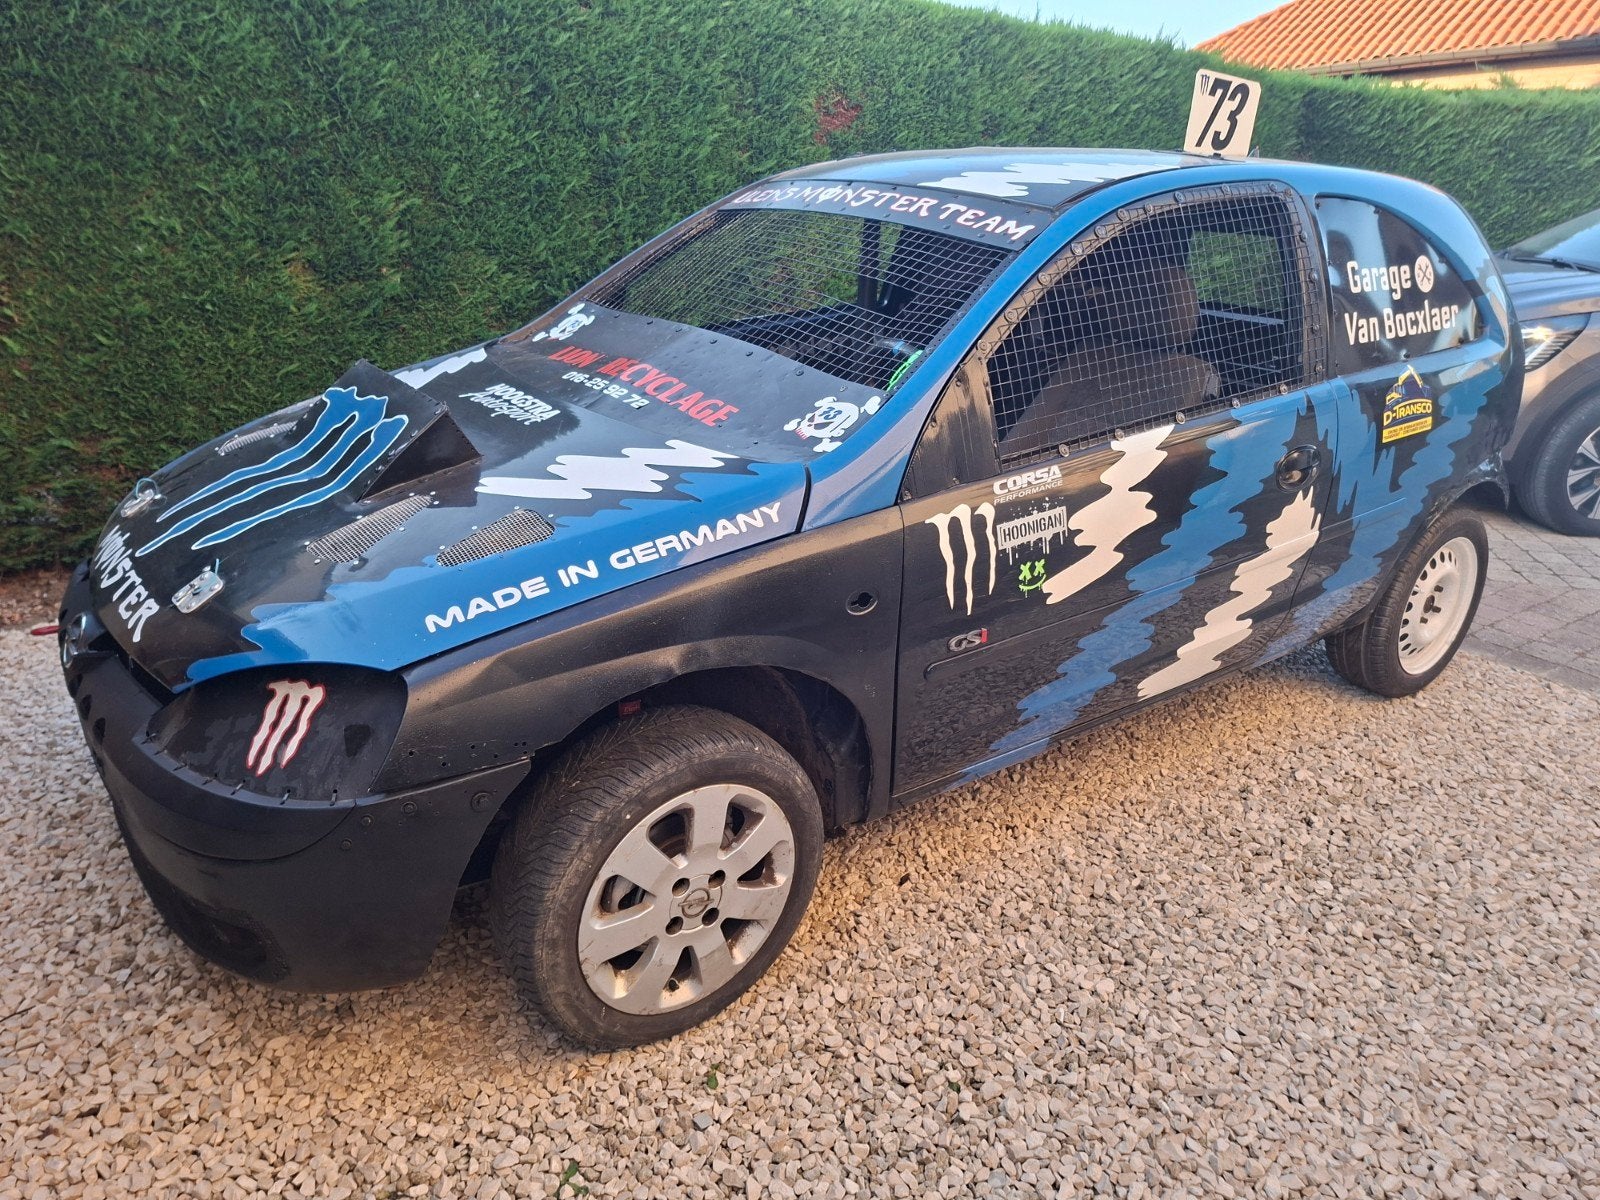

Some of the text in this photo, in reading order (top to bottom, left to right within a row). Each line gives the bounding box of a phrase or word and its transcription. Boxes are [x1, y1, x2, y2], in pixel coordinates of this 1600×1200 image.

[1194, 77, 1250, 151] 73
[938, 203, 1035, 240] TEAM
[1346, 260, 1412, 301] Garage
[1344, 299, 1459, 346] Van Bocxlaer
[596, 357, 740, 427] RECYCLAGE
[602, 384, 629, 399] 92
[622, 393, 650, 409] 72
[993, 465, 1062, 495] CORSA
[994, 480, 1063, 506] PERFORMANCE
[424, 502, 781, 634] MADE IN GERMANY
